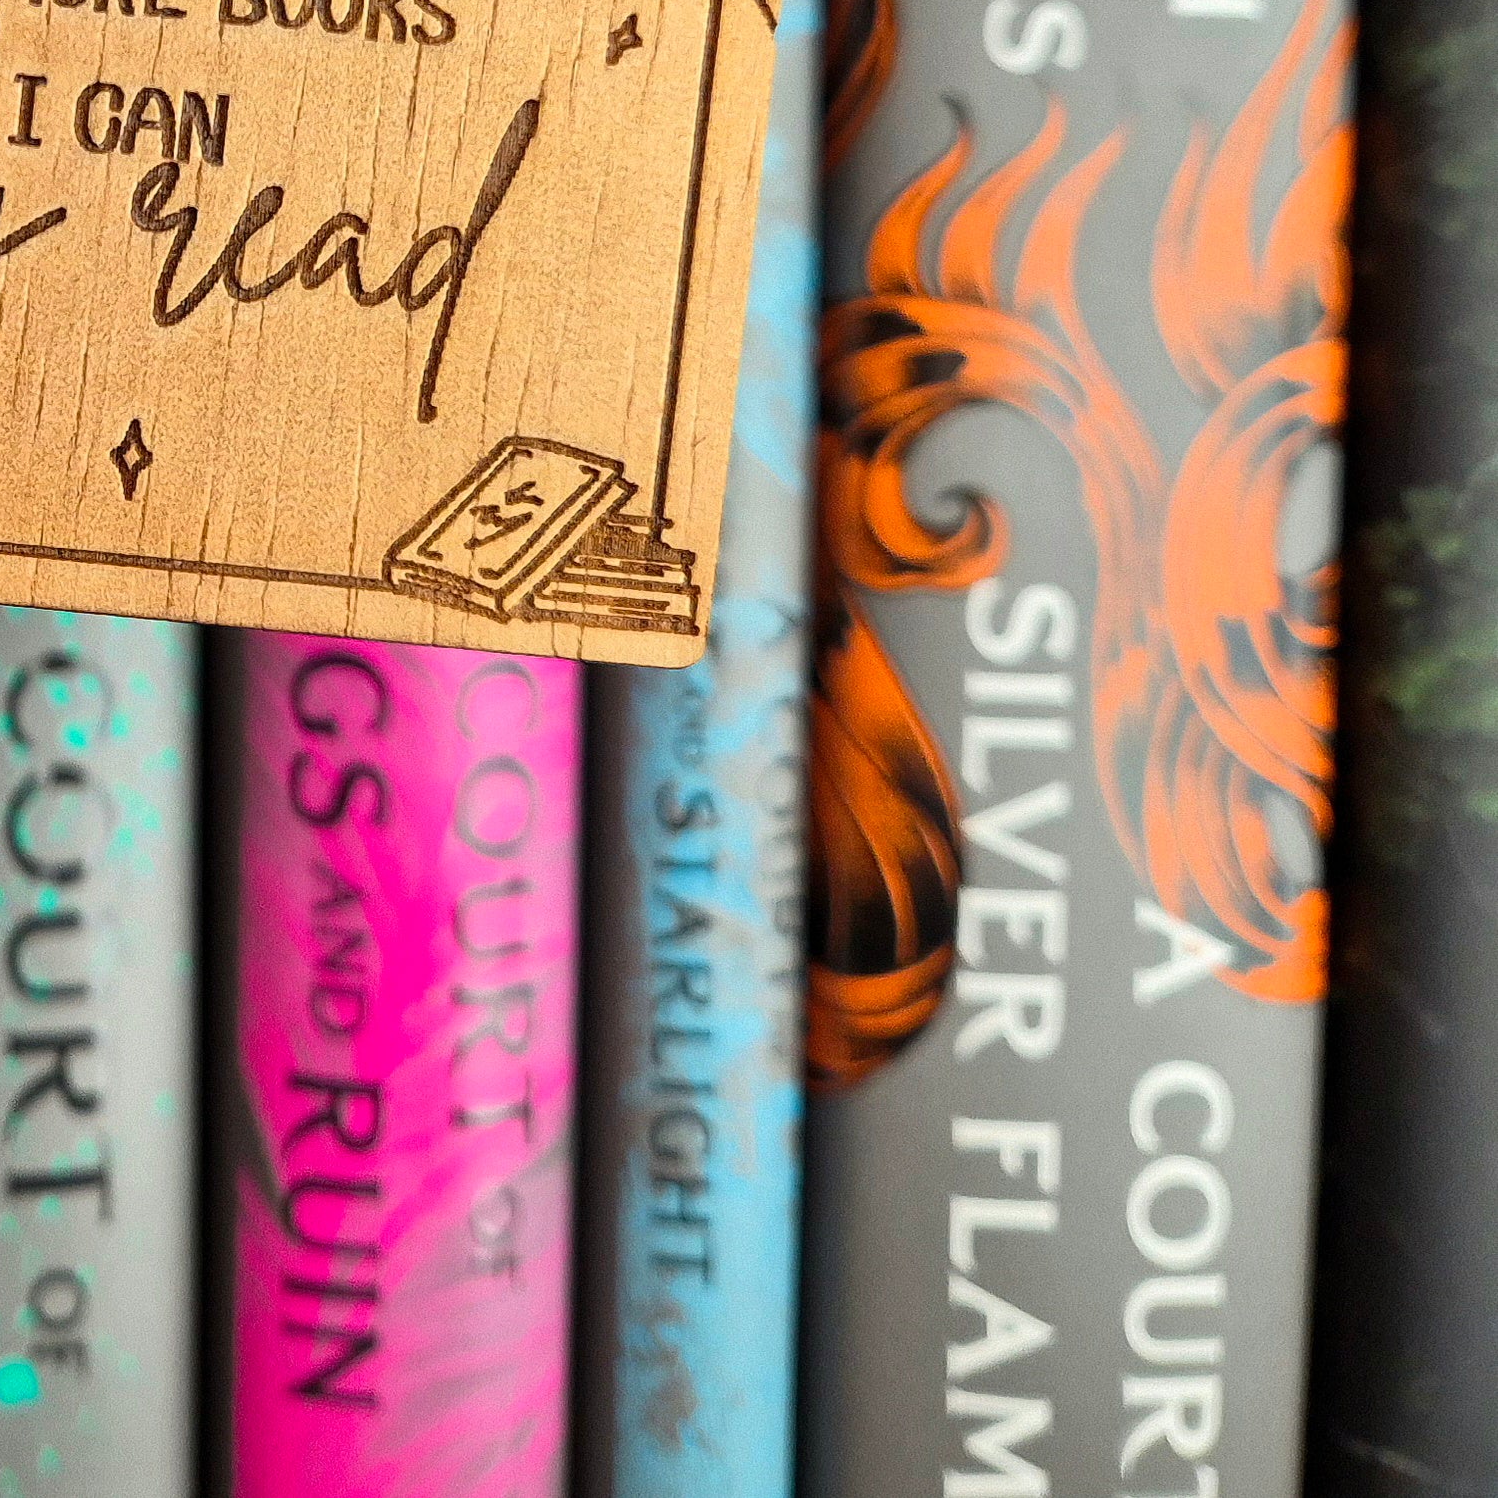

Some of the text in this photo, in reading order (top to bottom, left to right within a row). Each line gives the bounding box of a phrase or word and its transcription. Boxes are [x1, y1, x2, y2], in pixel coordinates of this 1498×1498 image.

[6, 71, 47, 147] I
[74, 82, 230, 166] CAN
[133, 97, 541, 423] read
[2, 648, 116, 1228] COURT
[306, 858, 368, 1037] AND
[452, 658, 543, 1145] COURT
[954, 576, 1079, 1063] SILVER
[1132, 900, 1234, 1005] A
[279, 1068, 388, 1411] RUIN
